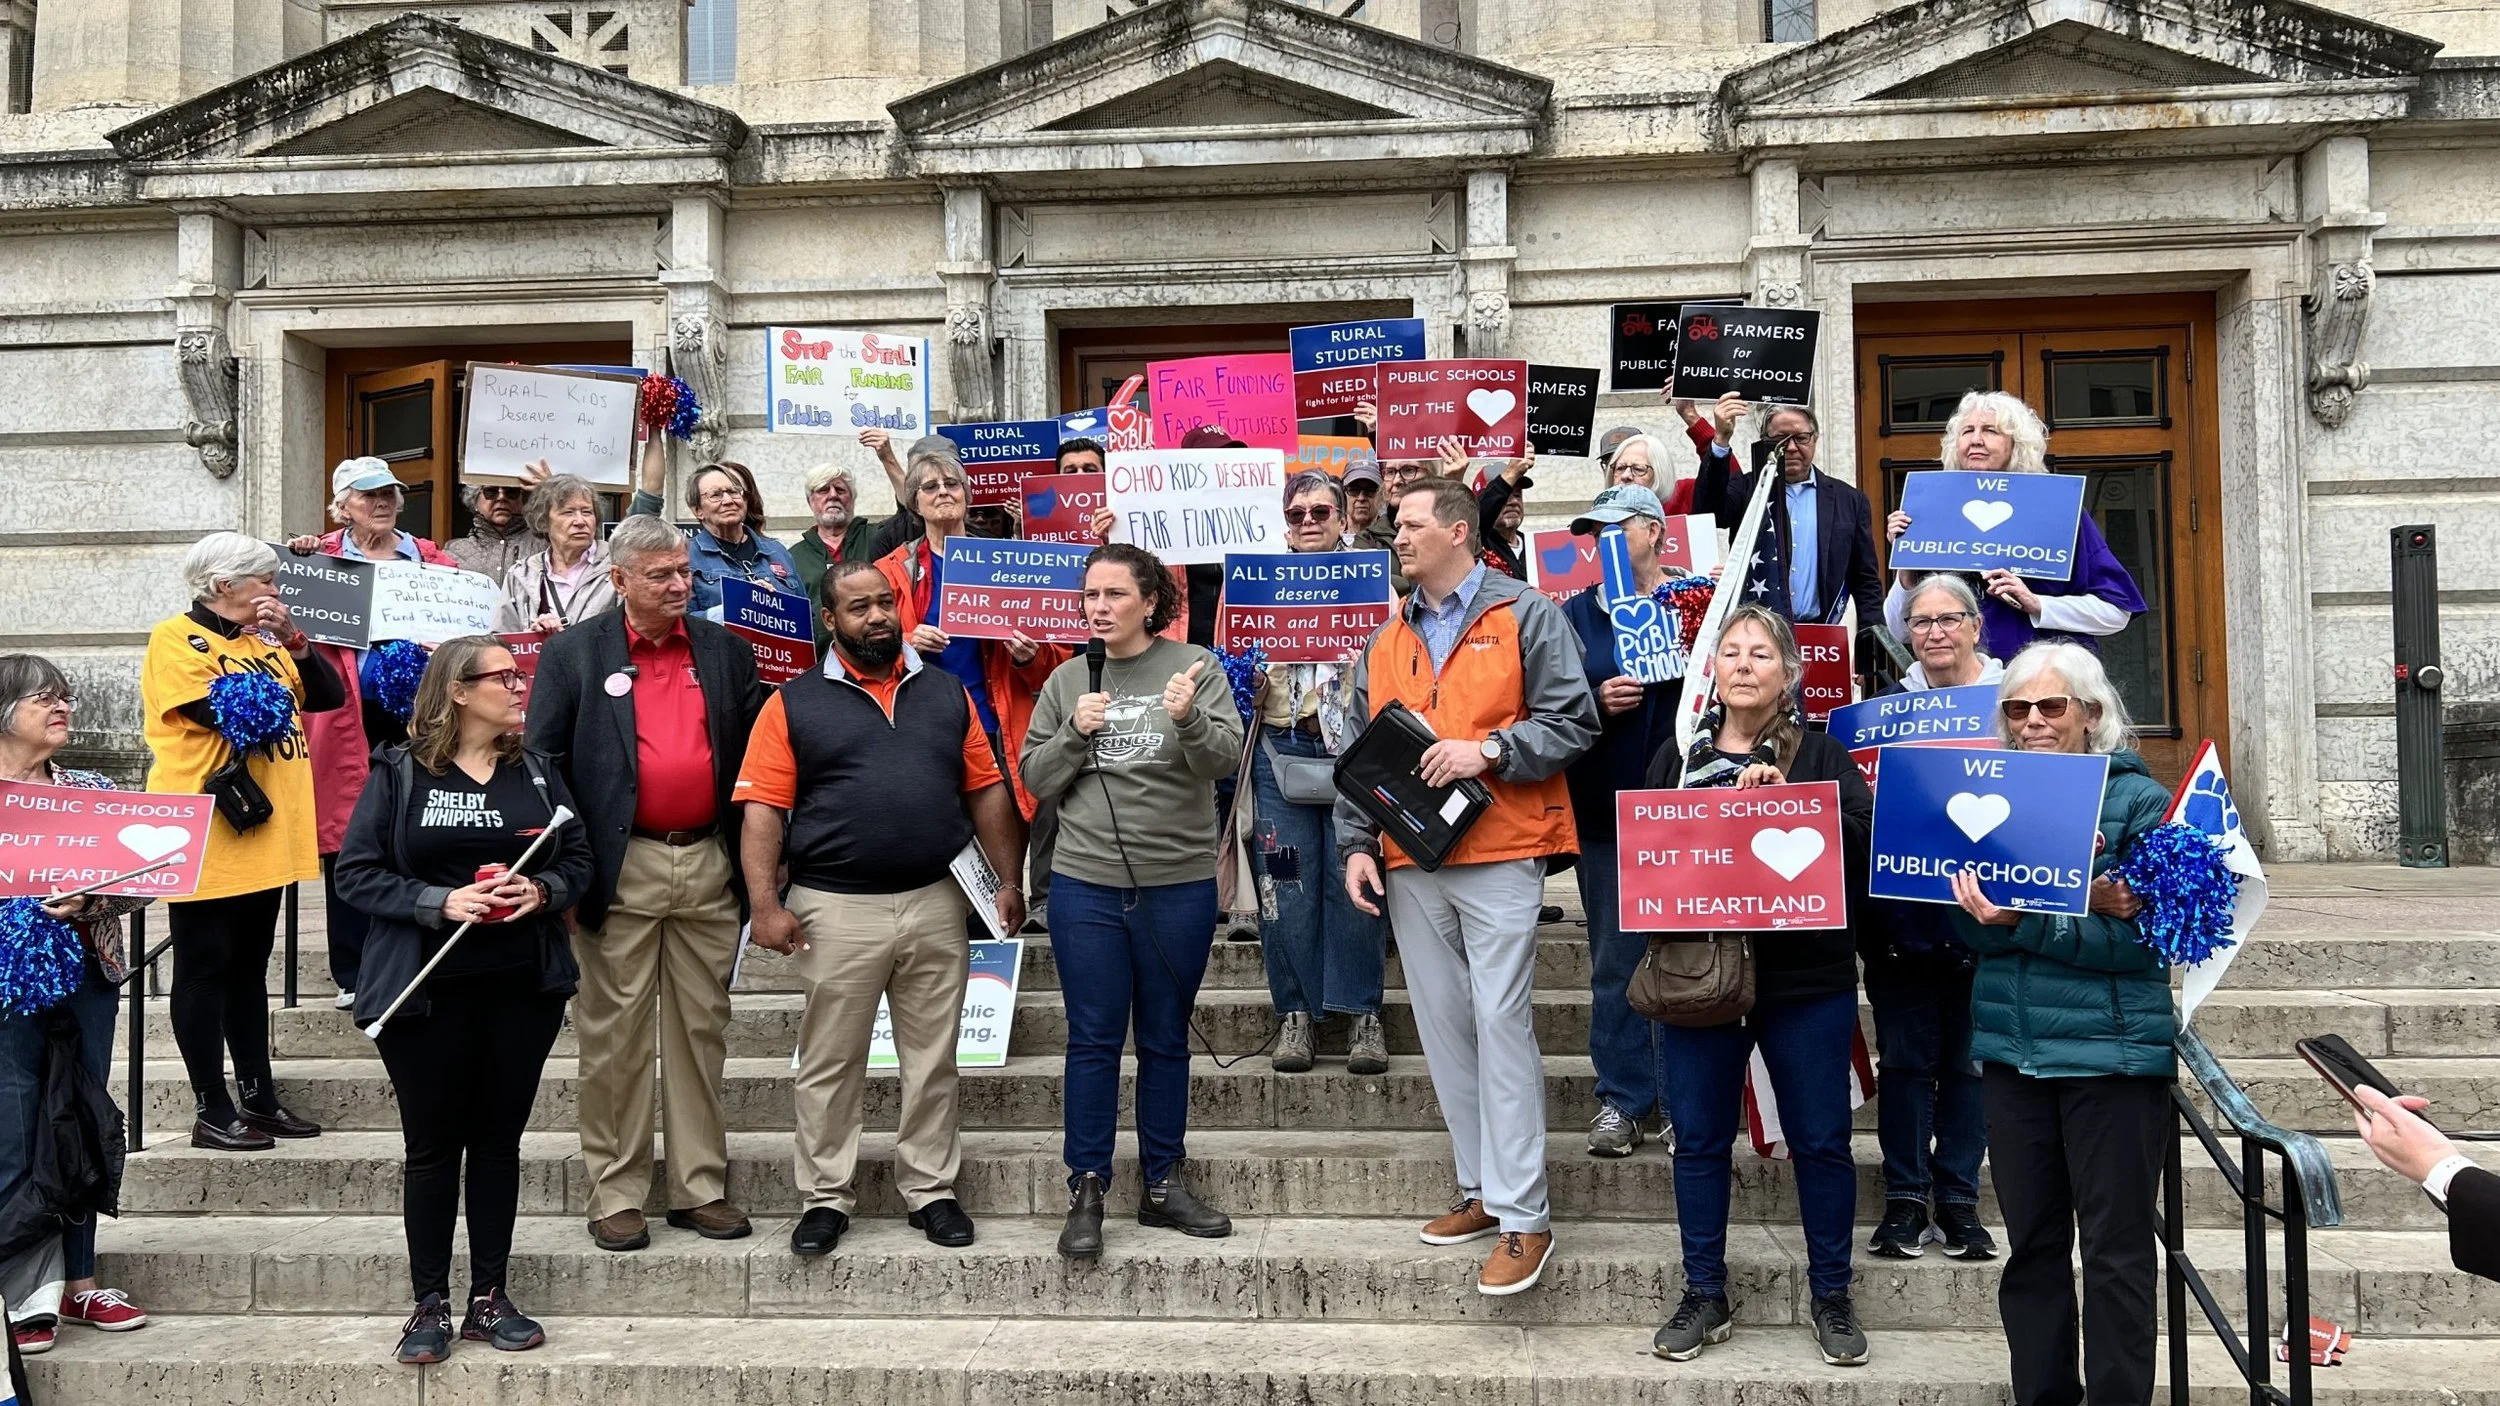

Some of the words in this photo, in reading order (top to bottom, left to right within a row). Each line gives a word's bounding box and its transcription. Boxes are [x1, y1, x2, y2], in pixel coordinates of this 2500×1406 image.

[1331, 326, 1386, 343] RURAL
[1723, 324, 1805, 341] FARMERS
[781, 330, 833, 361] STOP
[839, 343, 857, 359] the
[862, 333, 917, 367] STEAL!
[1315, 345, 1404, 364] STUDENTS
[1732, 348, 1753, 360] for
[1620, 359, 1667, 370] PUBLIC
[1388, 370, 1439, 384] PUBLIC
[1446, 369, 1516, 382] SCHOOLS
[1681, 366, 1729, 379] PUBLIC
[1732, 367, 1803, 383] SCHOOLS
[1158, 369, 1206, 402] FAIR
[1215, 366, 1285, 396] FUNDING
[1322, 378, 1367, 395] NEED
[1527, 381, 1587, 397] RMERS
[843, 386, 859, 400] for
[1305, 398, 1325, 407] fight
[1326, 396, 1338, 405] for
[1341, 395, 1355, 403] fair
[1357, 393, 1377, 402] scho
[1389, 403, 1419, 416] PUT
[1425, 401, 1455, 414] THE
[1527, 405, 1539, 414] or
[1217, 410, 1288, 436] FUTURES
[974, 427, 1025, 441] RURAL
[1109, 415, 1155, 450] PUBLI
[960, 444, 1041, 459] STUDENTS
[1389, 437, 1405, 450] IN
[968, 473, 1008, 486] NEED
[1112, 465, 1163, 494] OHIO
[1170, 463, 1207, 492] KIDS
[1215, 461, 1277, 489] DESERVE
[1976, 478, 2009, 492] WE
[971, 488, 983, 496] for
[985, 487, 998, 495] fair
[1059, 492, 1104, 508] VOT
[1079, 512, 1095, 524] fo
[1128, 509, 1172, 550] FAIR
[1183, 505, 1266, 548] FUNDING
[1031, 531, 1078, 542] PUBLIC
[951, 549, 985, 564] ALL
[1898, 540, 1967, 555] PUBLIC
[1970, 542, 2068, 563] SCHOOLS
[279, 561, 361, 586] ARMERS
[990, 570, 1051, 585] deserve
[1231, 566, 1268, 581] ALL
[1274, 563, 1383, 581] STUDENTS
[279, 583, 302, 596] for
[1275, 587, 1340, 601] deserve
[386, 589, 432, 604] Public
[437, 592, 491, 612] Education
[752, 590, 785, 611] RURAL
[947, 592, 990, 608] FAIR
[1001, 597, 1031, 609] and
[1041, 597, 1083, 612] FUL
[284, 603, 361, 626] CHOOLS
[381, 609, 415, 623] Fund
[420, 609, 462, 626] Public
[740, 607, 797, 633] STUDENTS
[947, 612, 1012, 627] SCHOOL
[1017, 616, 1089, 630] FUNDING
[1231, 614, 1276, 629] FAIR
[1287, 615, 1319, 629] and
[1331, 612, 1380, 629] FULL
[1618, 605, 1680, 660] PUBLI
[511, 642, 543, 655] BLIC
[1232, 636, 1301, 649] SCHOOL
[1306, 636, 1370, 648] FUNDIN
[752, 643, 772, 659] EED
[775, 649, 792, 663] US
[1801, 646, 1840, 663] ERS
[764, 663, 785, 673] school
[786, 666, 806, 675] fundi
[1622, 650, 1689, 684] SCHOO
[1804, 687, 1844, 698] OOLS
[1880, 694, 1958, 717] RURAL
[1854, 715, 1981, 743] STUDENTS
[1096, 734, 1164, 749] KINGS
[1963, 758, 2007, 778] WE
[5, 794, 84, 813] PUBLIC
[93, 802, 195, 818] SCHOOLS
[427, 788, 487, 809] SHELBY
[420, 807, 504, 828] WHIPPETS
[1634, 803, 1708, 821] PUBLIC
[1719, 798, 1822, 818] SCHOOLS
[0, 833, 46, 847] PUT
[56, 835, 100, 847] THE
[1637, 850, 1680, 866] PUT
[1690, 848, 1734, 865] THE
[1877, 853, 1957, 877] PUBLIC
[1964, 860, 2082, 889] SCHOOLS
[1638, 897, 1663, 915] IN
[1677, 895, 1826, 915] HEARTLAND
[970, 949, 985, 960] EA
[961, 1004, 995, 1019] lic
[958, 1025, 997, 1043] ing.
